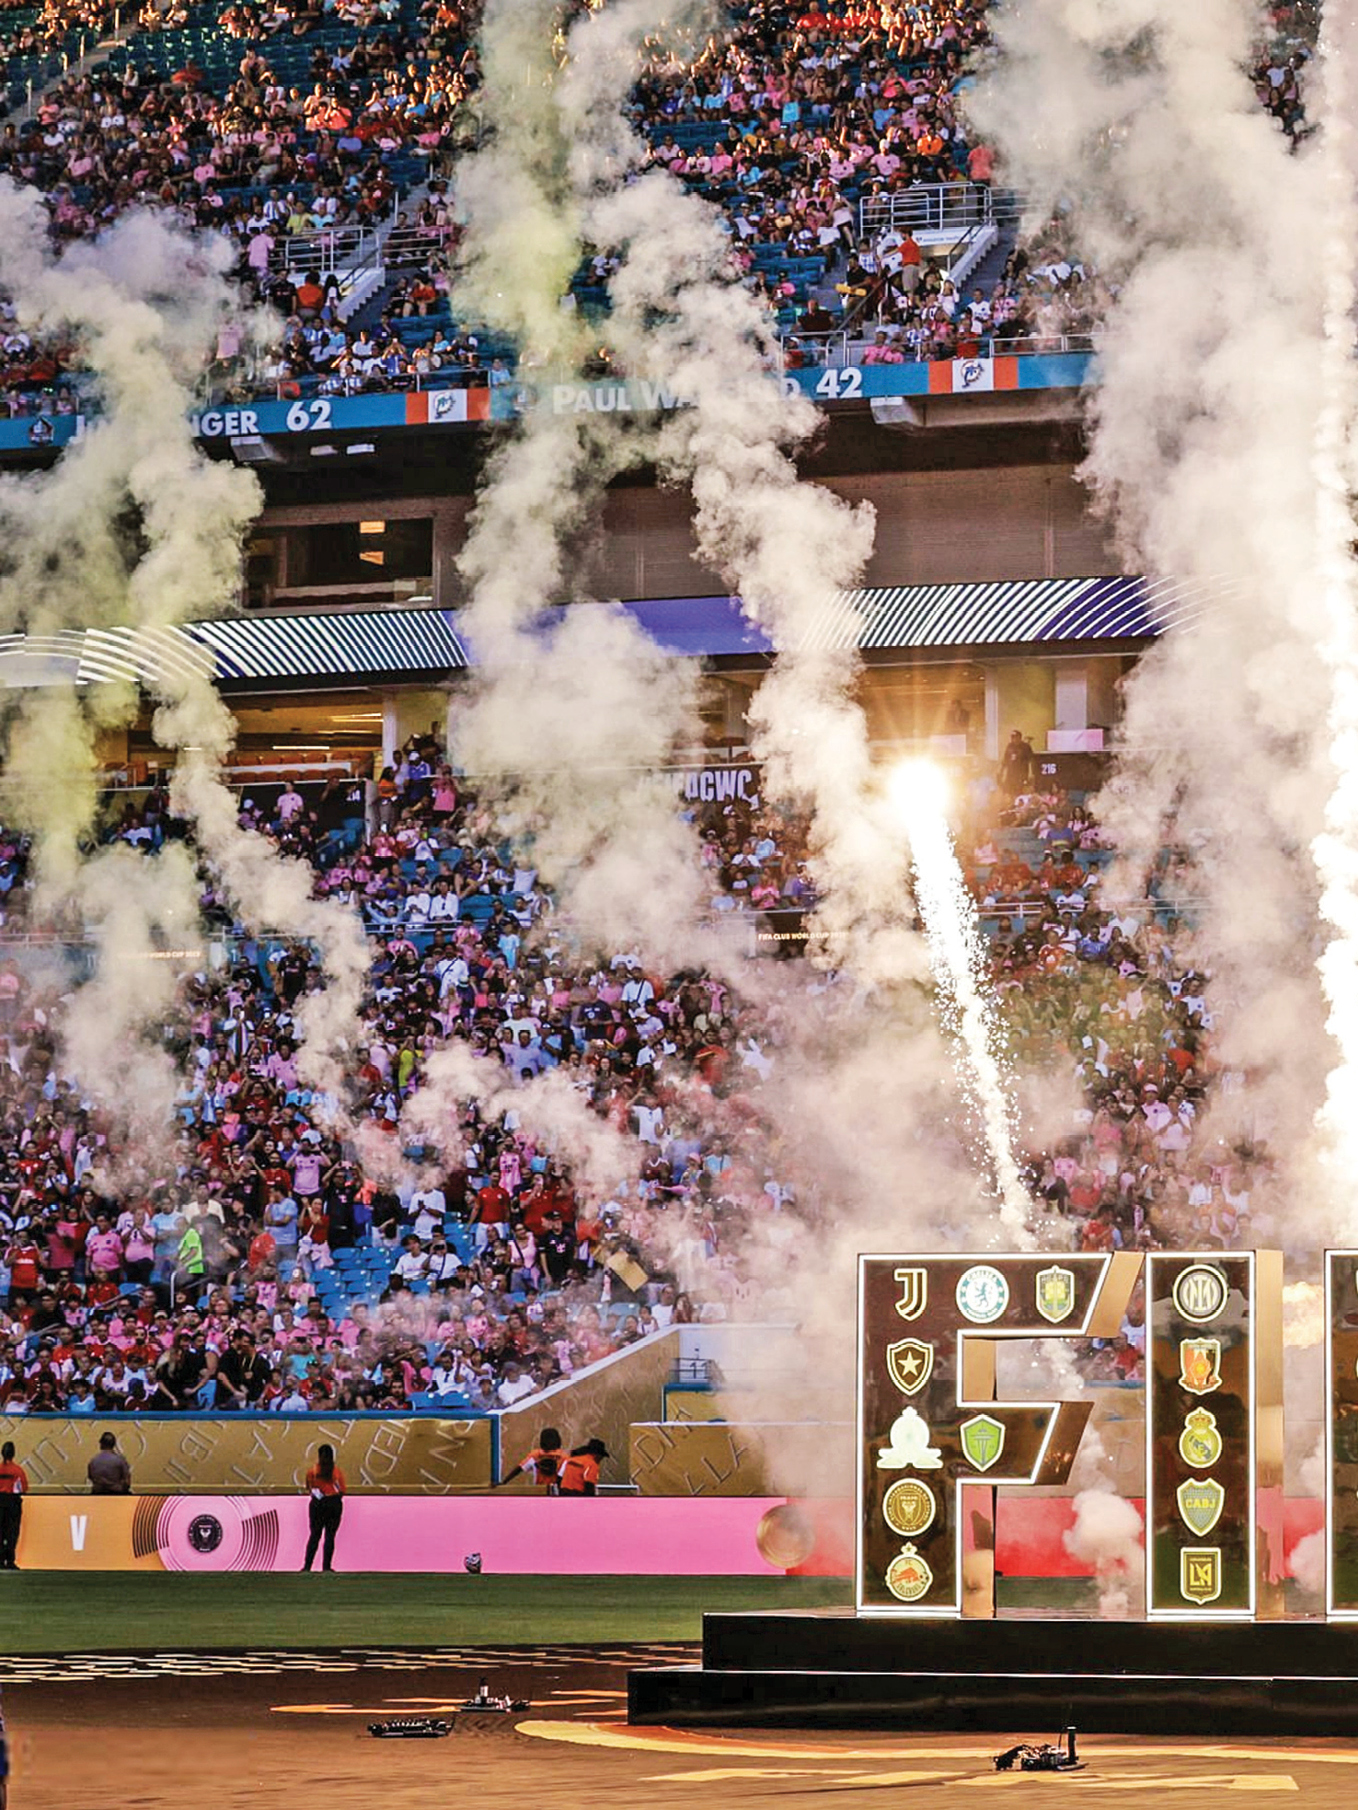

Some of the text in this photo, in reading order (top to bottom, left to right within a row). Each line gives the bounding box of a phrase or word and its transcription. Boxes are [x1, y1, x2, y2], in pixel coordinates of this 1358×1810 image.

[552, 383, 633, 414] PAUL
[816, 367, 863, 400] 42
[286, 400, 333, 432] 62
[1041, 763, 1057, 775] 216
[758, 933, 773, 941] FIFA
[773, 933, 790, 941] CLUB
[790, 932, 816, 940] WORLD
[1185, 1498, 1217, 1509] CABJ
[69, 1514, 88, 1551] V
